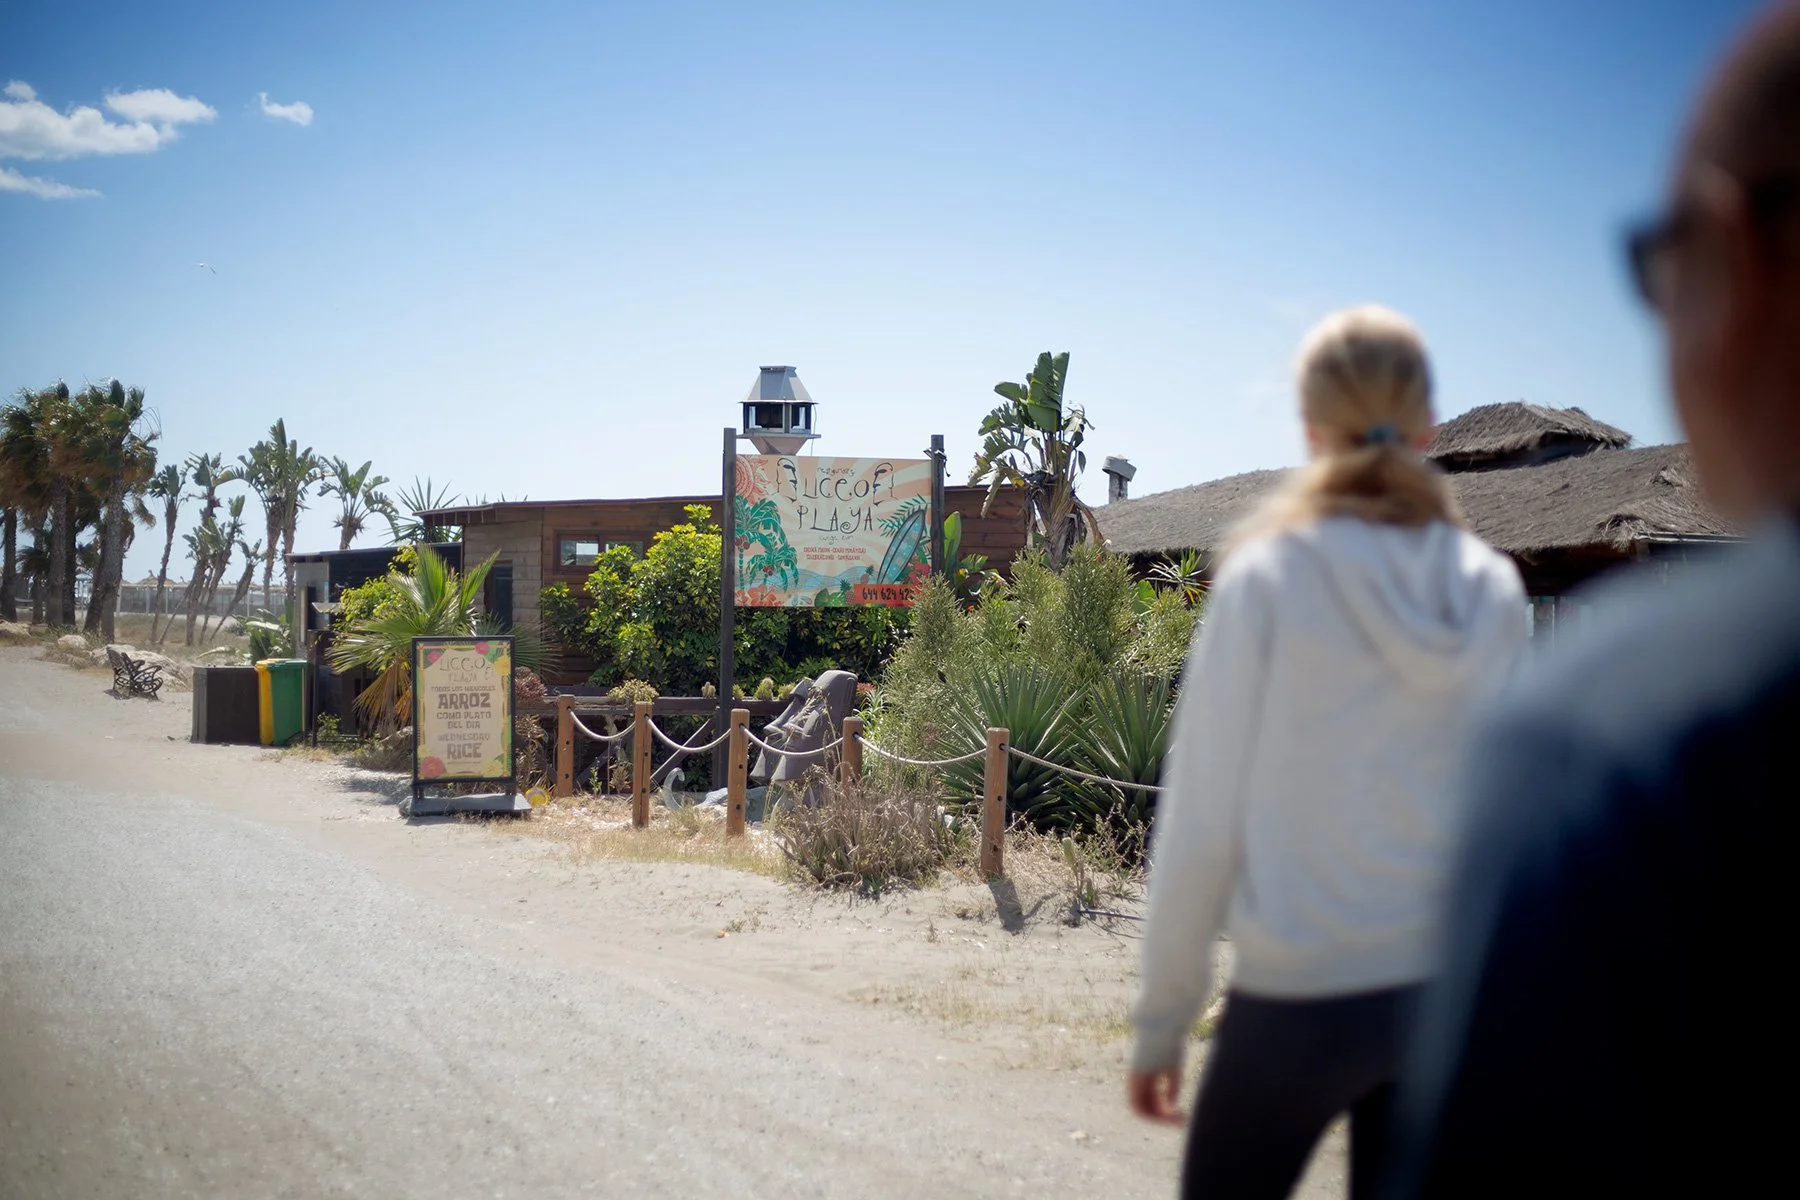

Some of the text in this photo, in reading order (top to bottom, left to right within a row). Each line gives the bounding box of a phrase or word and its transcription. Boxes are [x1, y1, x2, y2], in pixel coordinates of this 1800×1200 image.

[797, 505, 873, 534] PLAYA
[862, 587, 878, 600] 644
[881, 587, 897, 600] 624
[437, 693, 491, 710] ARROZ
[436, 711, 492, 720] COMO PLATO
[447, 721, 463, 730] DEL
[446, 743, 482, 760] RICE
